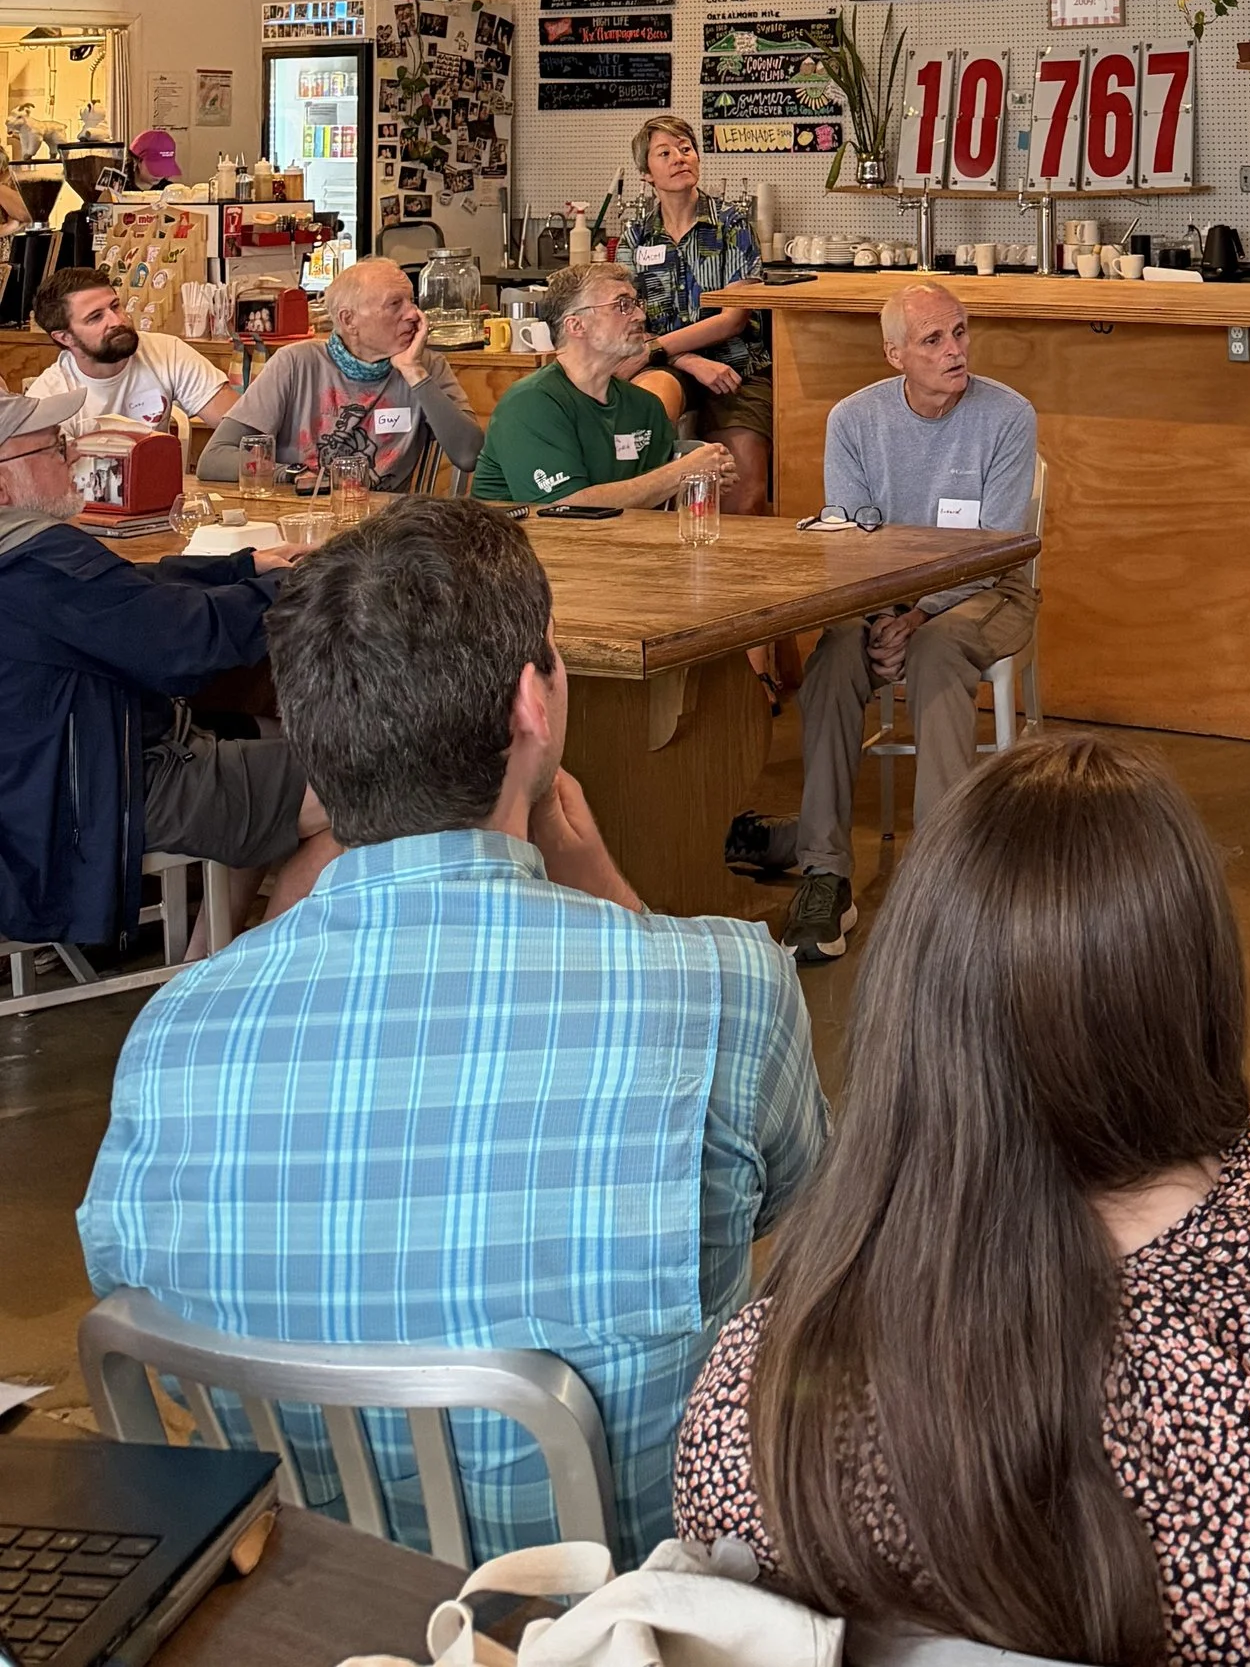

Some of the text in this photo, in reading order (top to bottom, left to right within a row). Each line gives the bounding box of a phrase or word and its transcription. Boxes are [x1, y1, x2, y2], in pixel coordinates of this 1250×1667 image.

[592, 16, 629, 27] HIGH LIFE
[728, 11, 758, 19] ALMOND
[588, 64, 624, 77] WHITE
[760, 70, 785, 81] CLIMB
[618, 83, 656, 97] BUBBLY
[749, 105, 783, 115] FOREVER
[916, 51, 1190, 179] 10 767
[723, 128, 776, 143] LEMONADE
[378, 414, 400, 427] Guy
